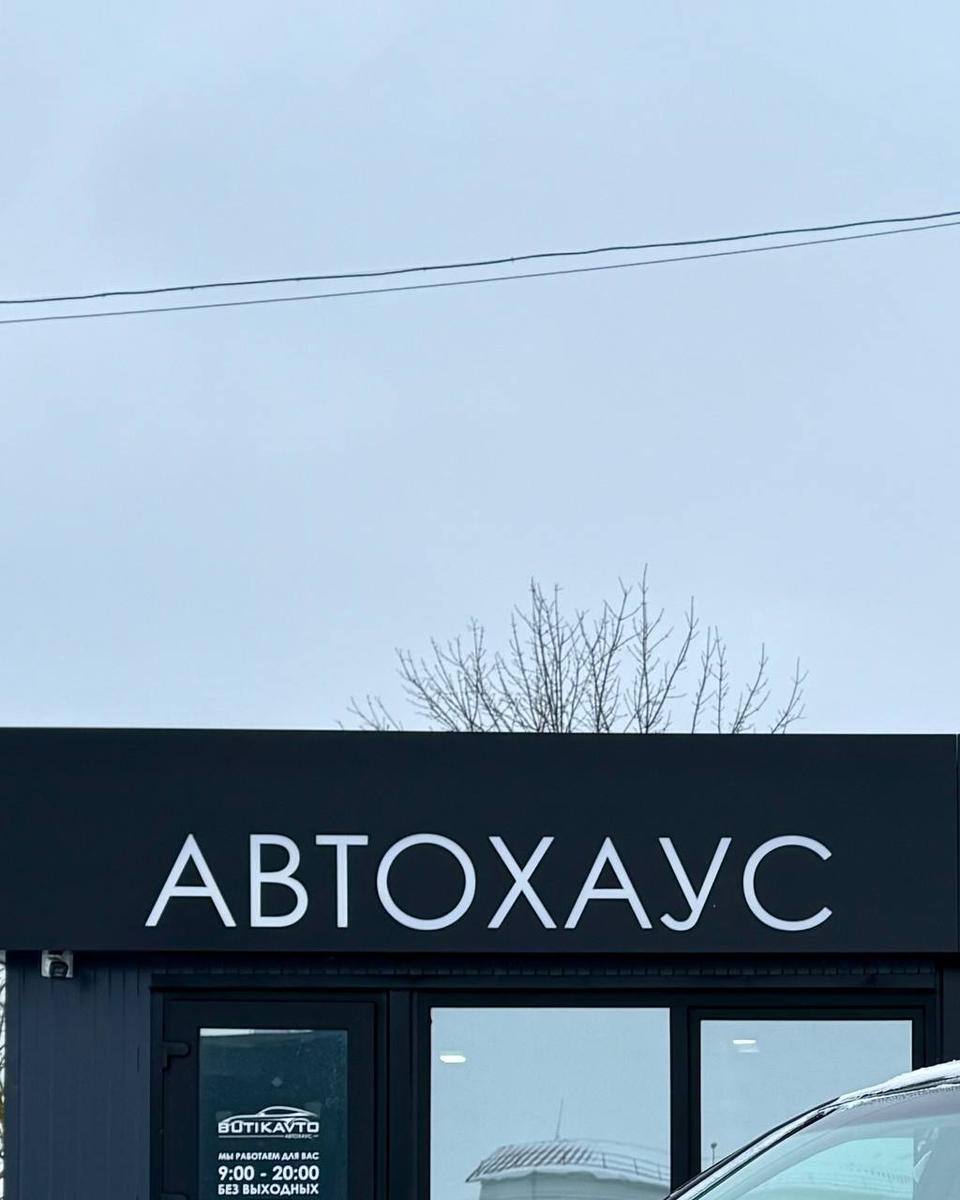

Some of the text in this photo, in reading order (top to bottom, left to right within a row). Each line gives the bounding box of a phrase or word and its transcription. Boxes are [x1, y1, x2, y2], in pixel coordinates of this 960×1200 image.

[145, 833, 834, 932] АВТОХАУС
[217, 1121, 320, 1134] BUTIKAVTO
[218, 1152, 319, 1161] МЫ РАБОТАЕМ ДЛЯ ВАС
[218, 1165, 255, 1181] 9:00
[272, 1165, 320, 1181] 20:00
[218, 1184, 319, 1196] БЕЗ ВЫХОДНЫХ
